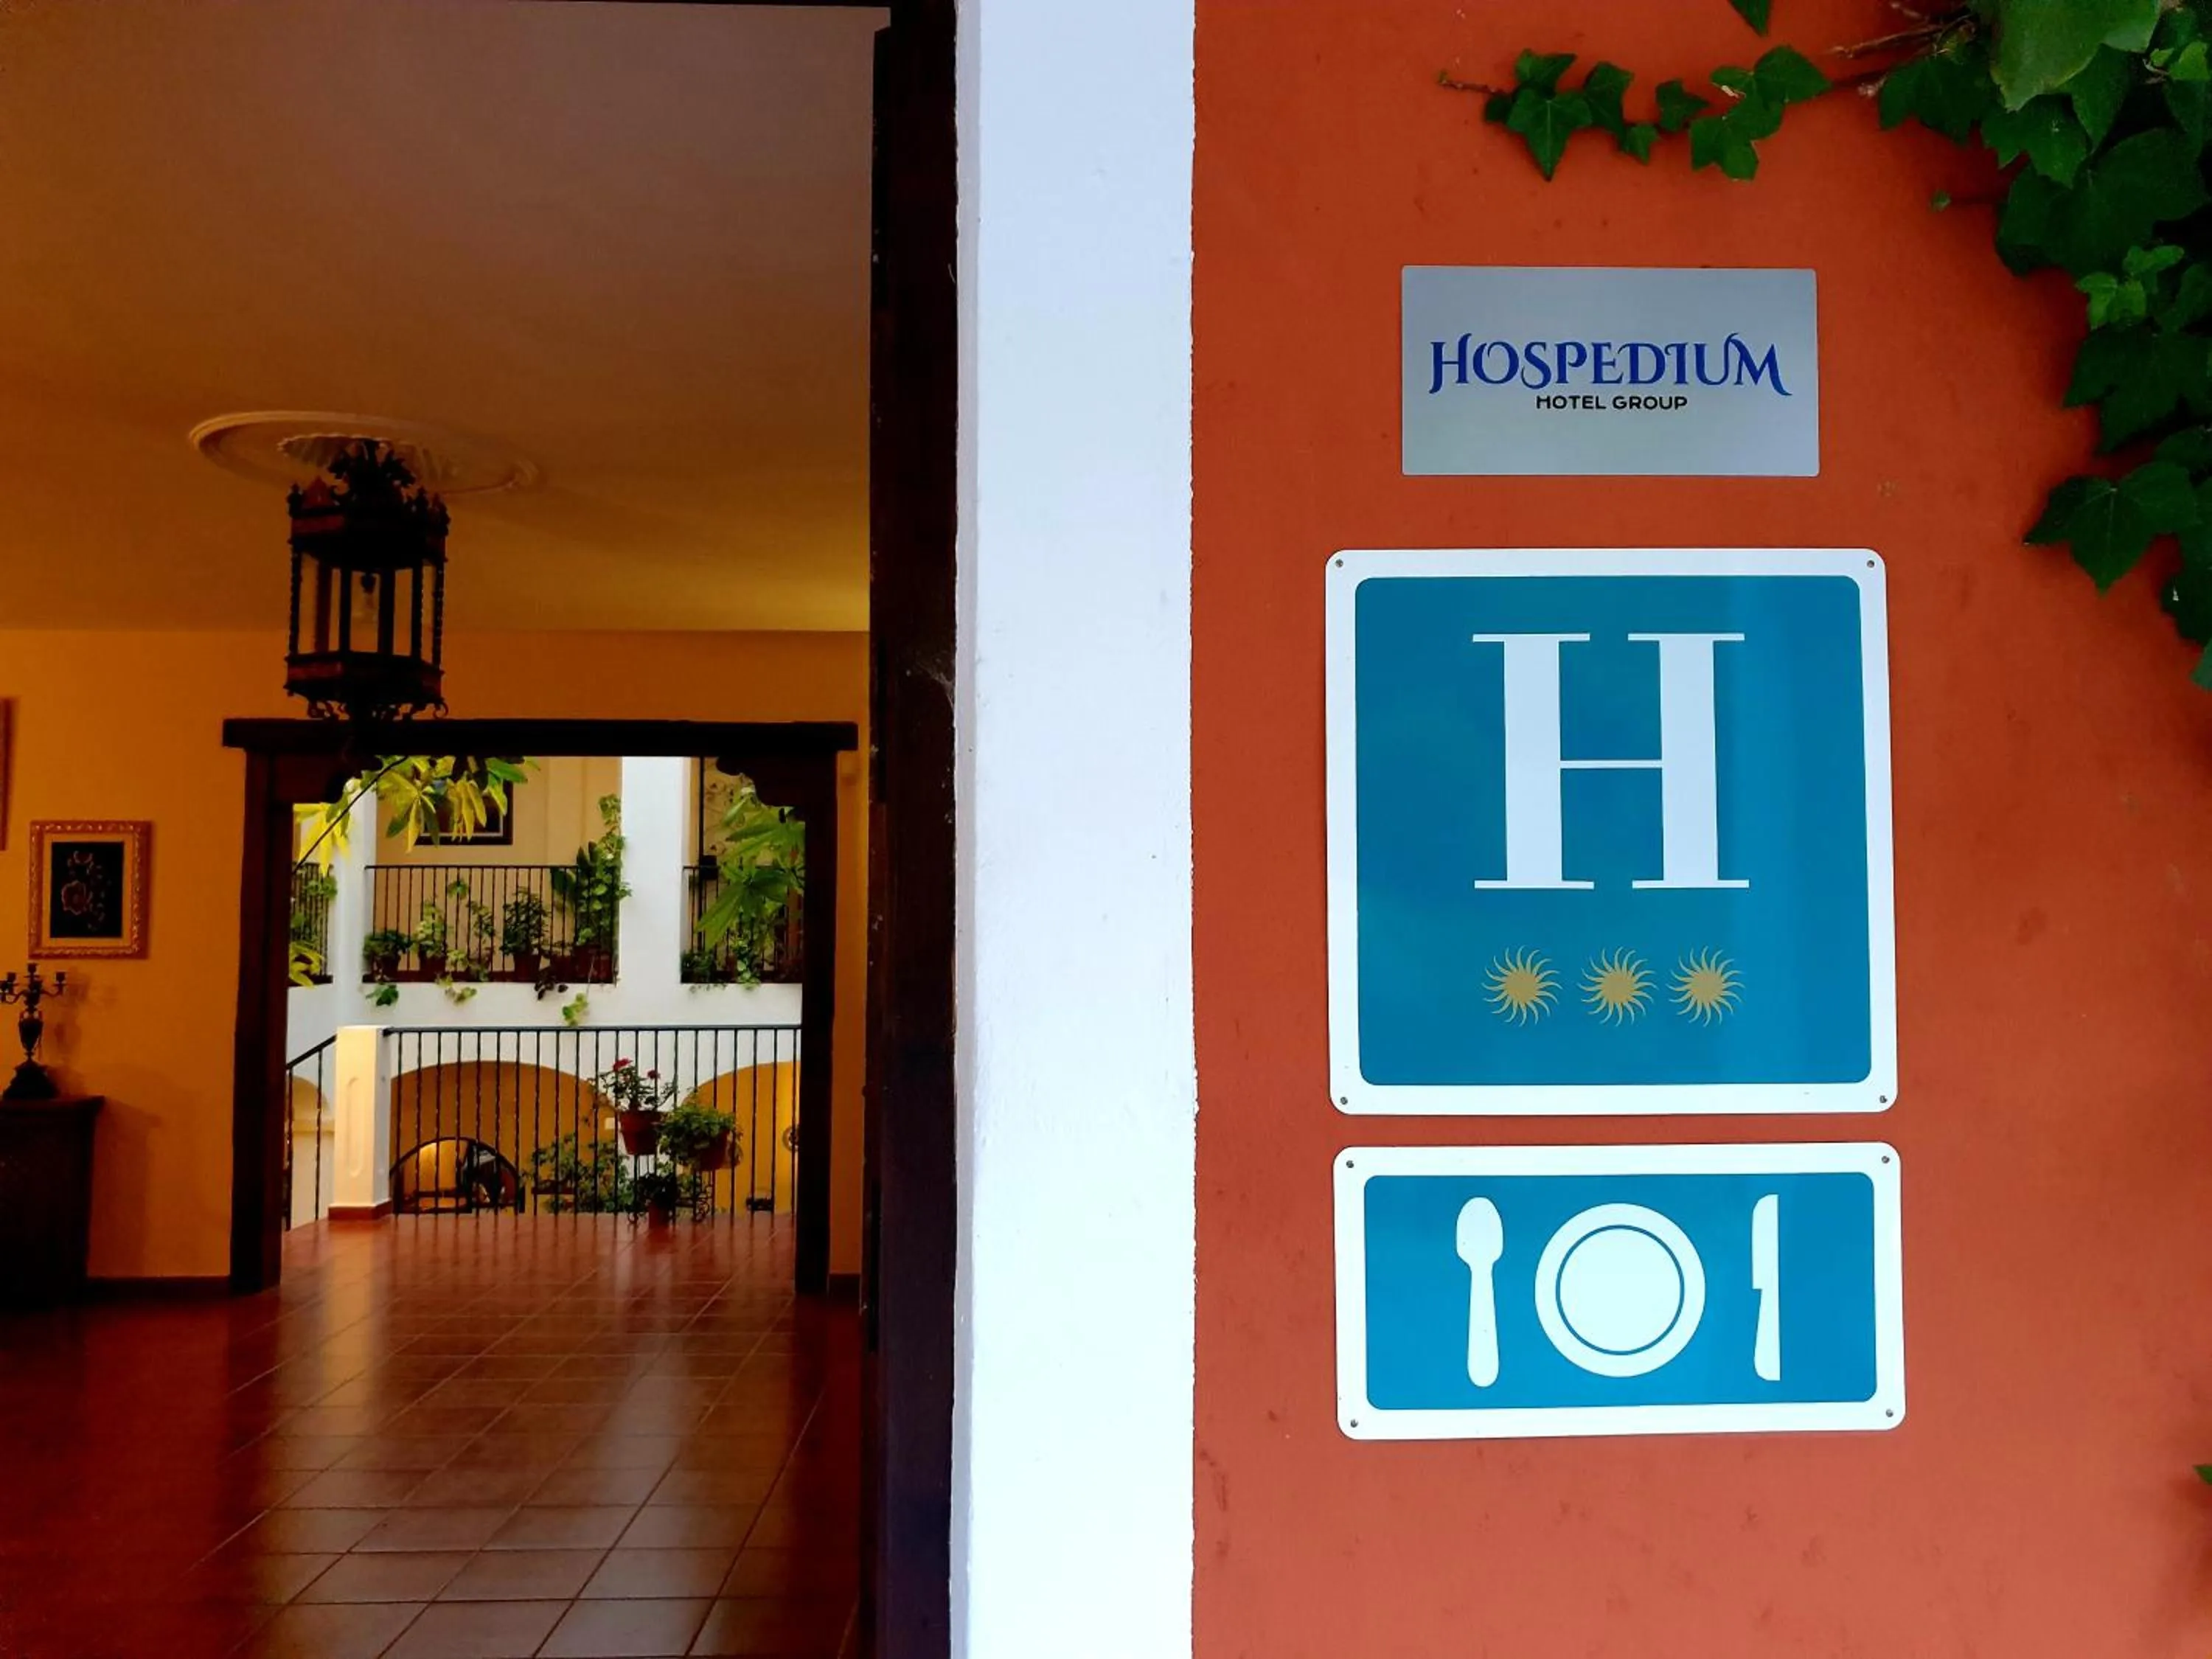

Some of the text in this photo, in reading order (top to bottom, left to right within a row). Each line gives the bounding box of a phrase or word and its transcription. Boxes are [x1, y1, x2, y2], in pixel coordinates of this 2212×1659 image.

[1428, 333, 1792, 396] HOSPEDIUM
[1535, 394, 1688, 411] HOTEL GROUP
[1472, 633, 1750, 889] H
